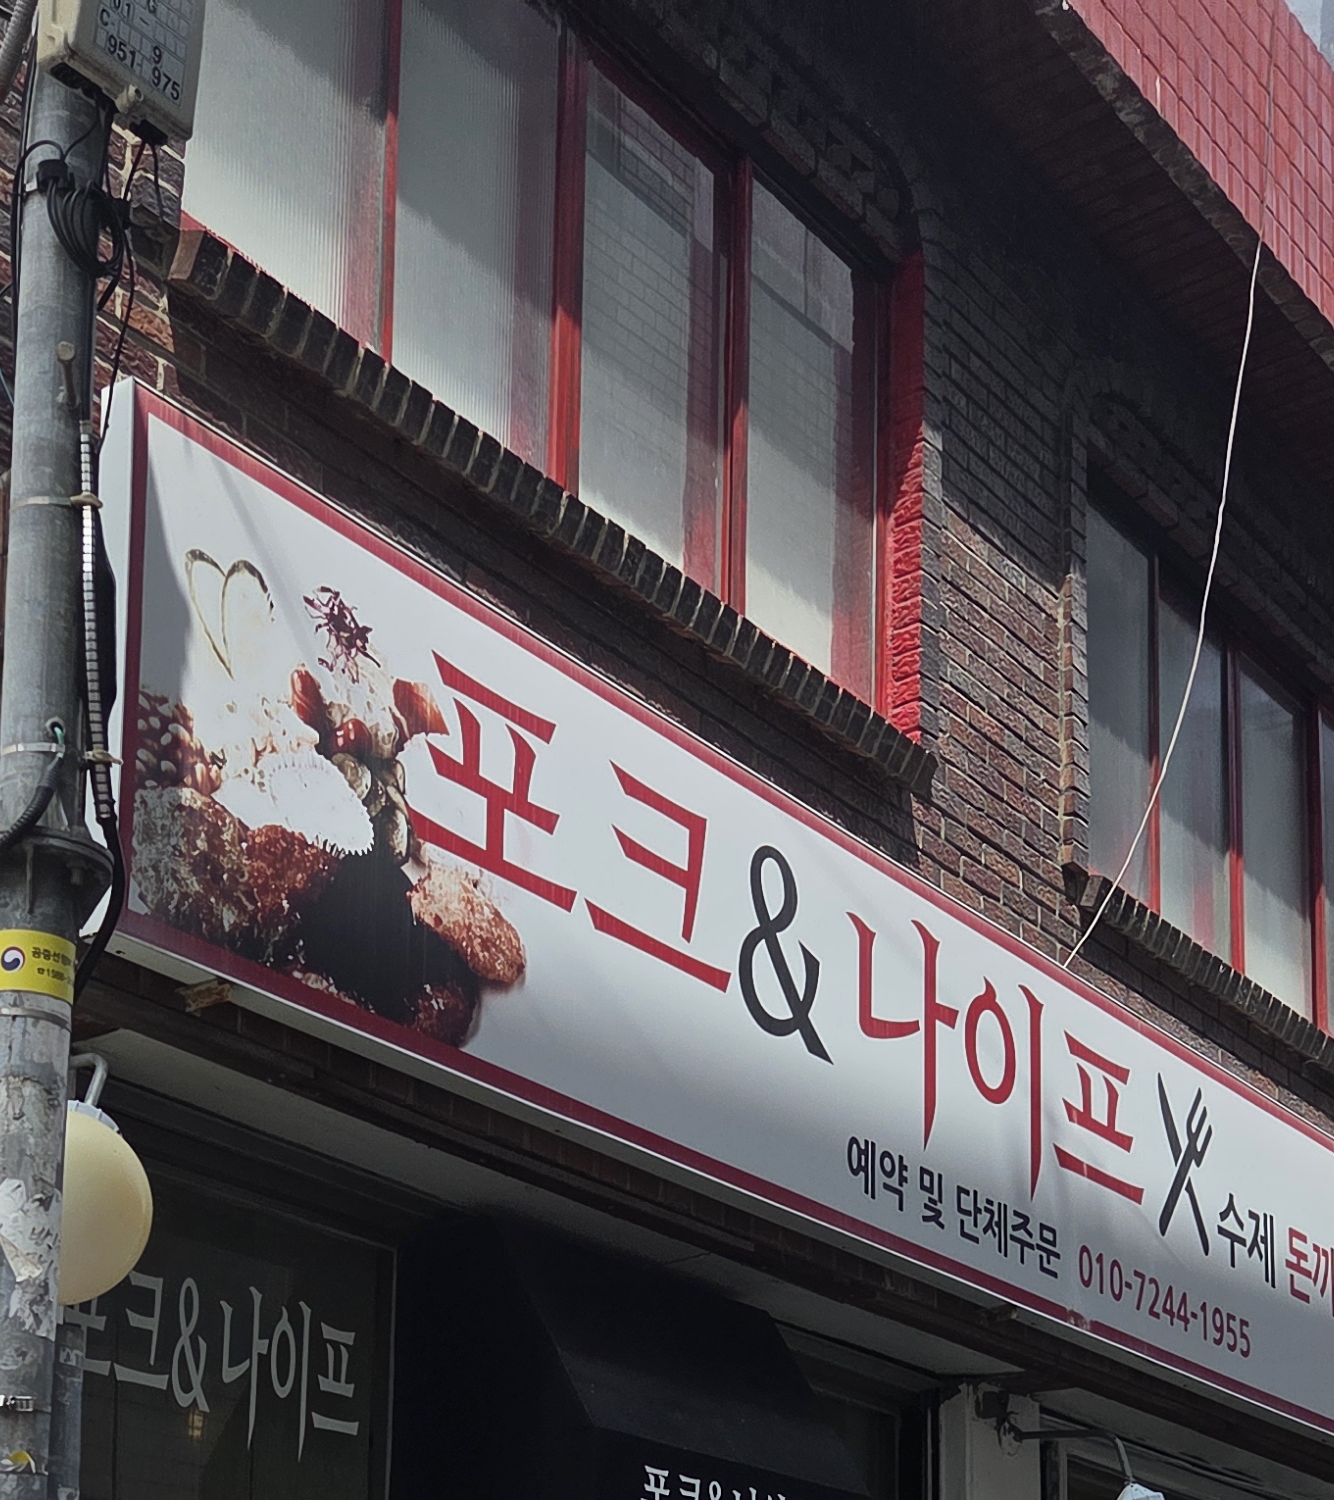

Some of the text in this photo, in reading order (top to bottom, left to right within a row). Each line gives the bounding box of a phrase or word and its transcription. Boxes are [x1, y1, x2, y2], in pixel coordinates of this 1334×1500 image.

[408, 649, 1145, 1205] 포크&나이프
[846, 1136, 1251, 1359] 예약 및 단체주문 010-7244-1955
[1217, 1193, 1276, 1289] 수제
